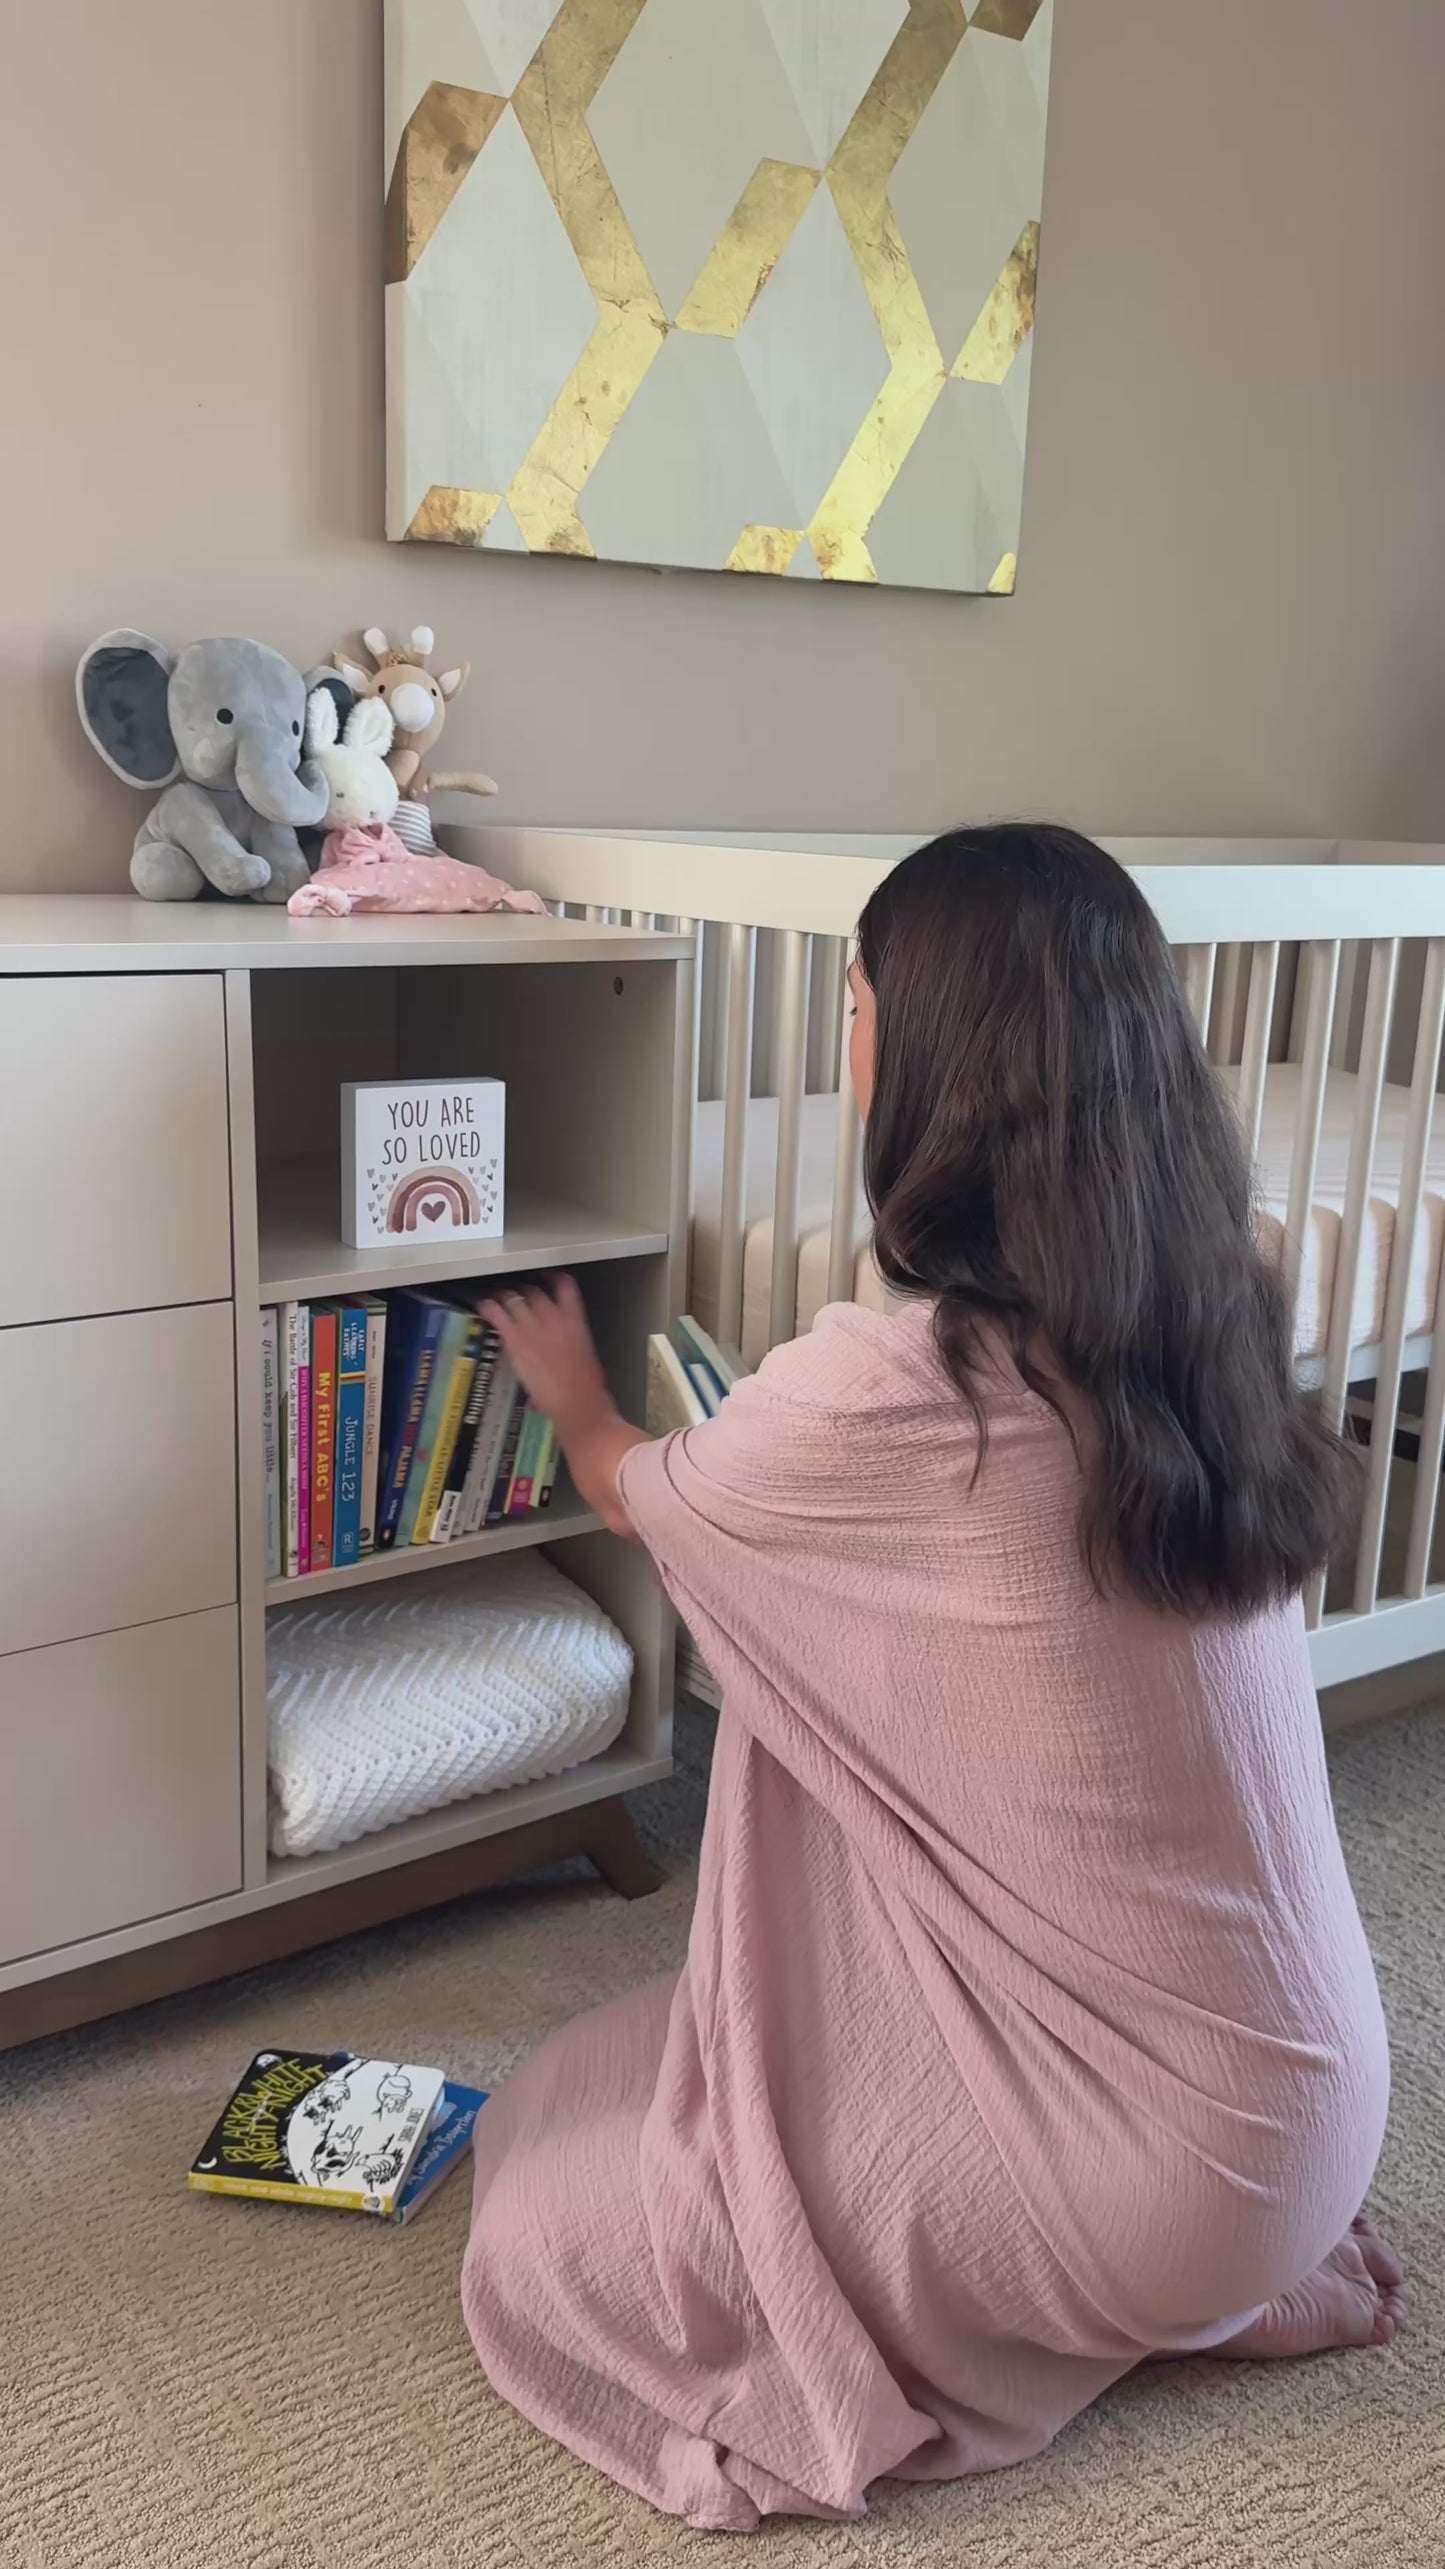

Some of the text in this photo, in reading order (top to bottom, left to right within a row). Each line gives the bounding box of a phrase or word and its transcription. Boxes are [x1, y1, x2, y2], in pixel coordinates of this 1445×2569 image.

[387, 1096, 474, 1130] YOU ARE
[382, 1131, 480, 1165] SO LOVED
[288, 1314, 297, 1331] The
[288, 1333, 297, 1355] Battle
[350, 1322, 358, 1360] LEARNING
[263, 1358, 273, 1388] could
[288, 1368, 297, 1380] Sir
[263, 1391, 273, 1418] keep
[288, 1403, 297, 1416] and
[365, 1376, 377, 1455] SUNRISE DANCE
[263, 1422, 273, 1442] you
[288, 1419, 297, 1431] Sir
[315, 1372, 331, 1502] My First ABC's
[342, 1416, 359, 1502] JUNGLE 123
